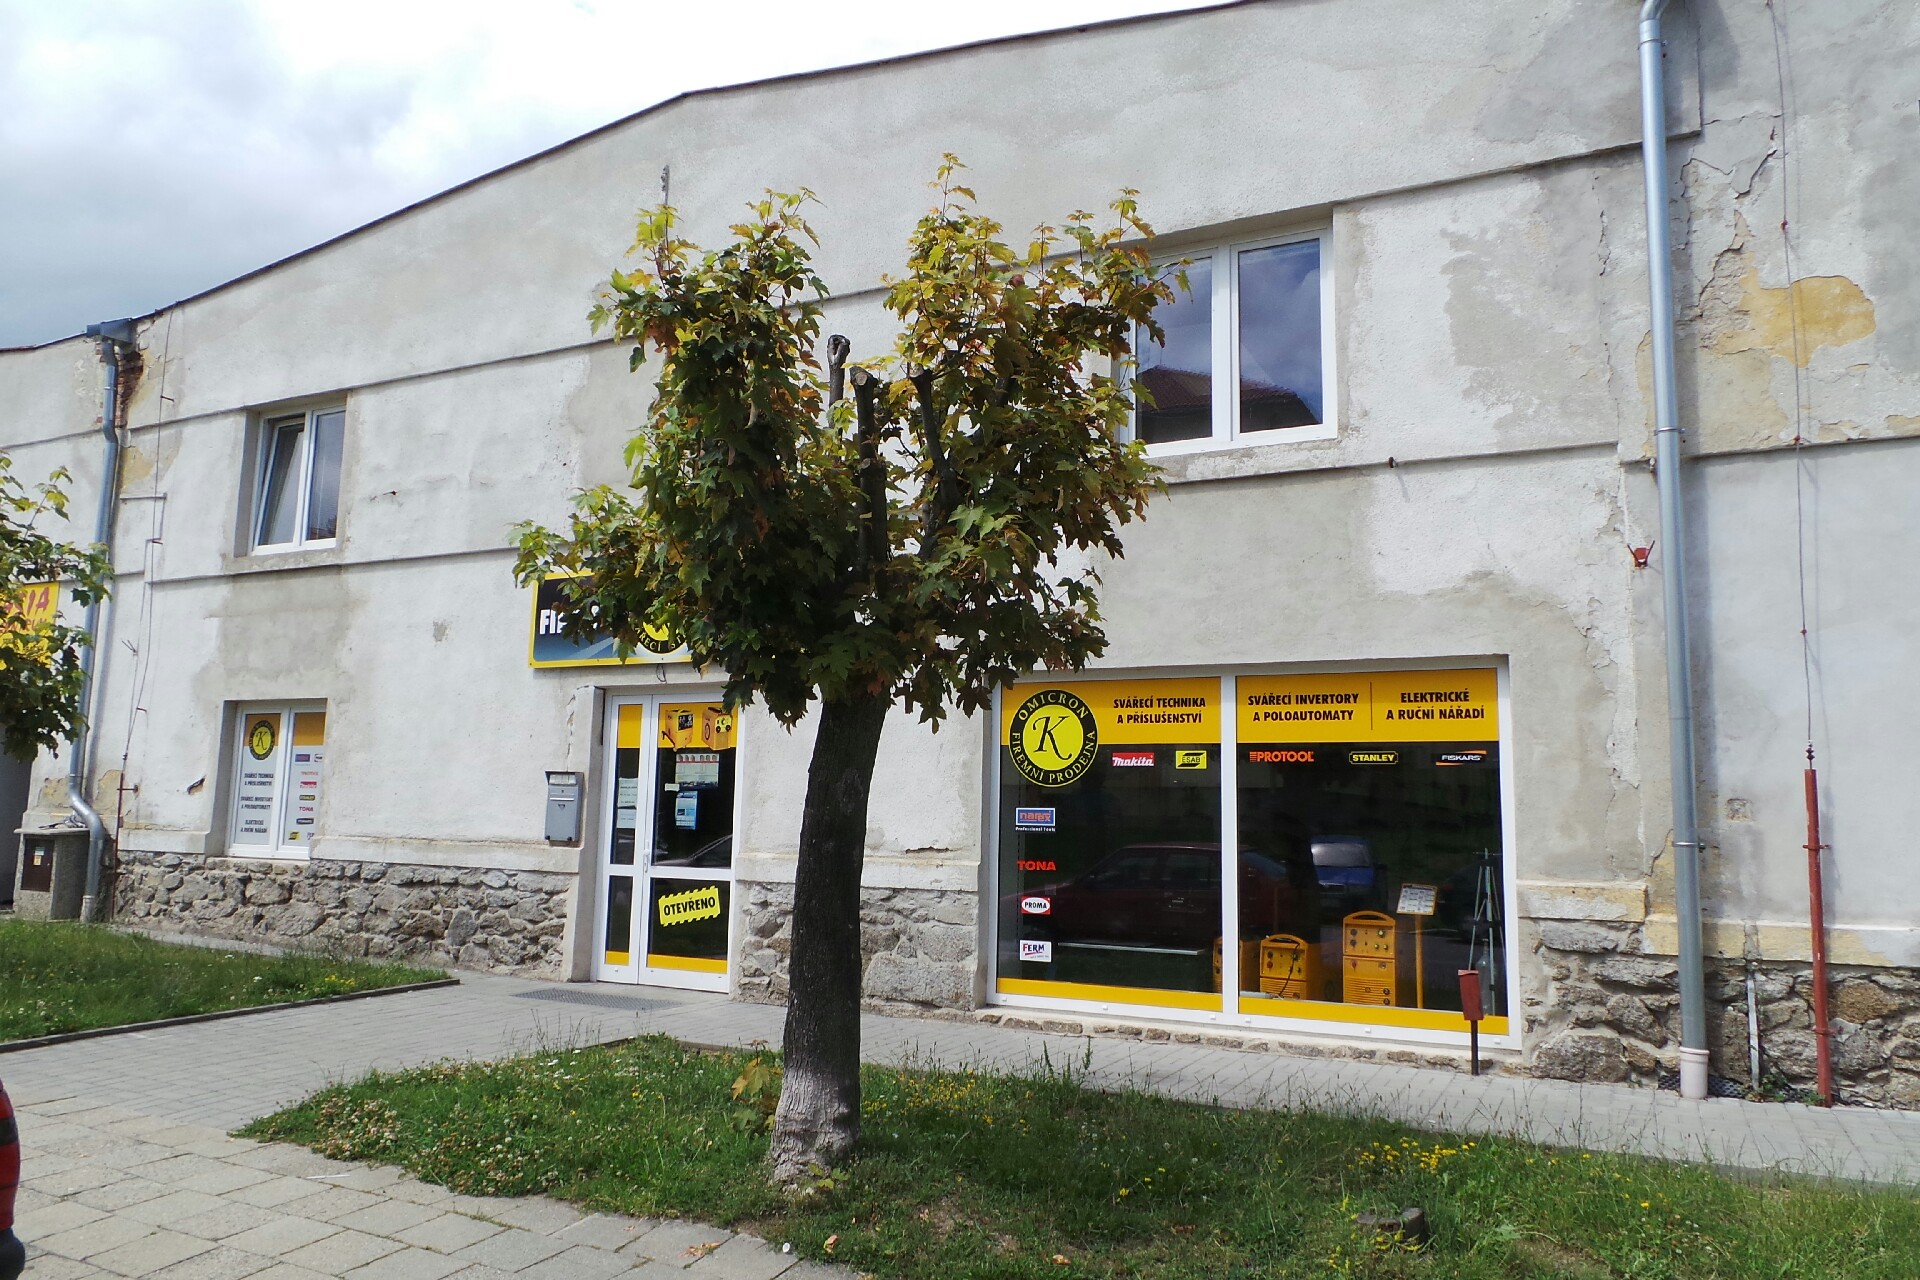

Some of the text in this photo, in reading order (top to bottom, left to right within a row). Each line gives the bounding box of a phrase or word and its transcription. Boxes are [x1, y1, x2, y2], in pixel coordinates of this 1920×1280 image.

[1113, 696, 1206, 709] SVÁŘECÍ TECHNIKA
[1248, 692, 1359, 706] SVÁŘECÍ INVERTORY
[1400, 688, 1470, 703] ELEKTRICKÉ
[1018, 692, 1089, 721] OMICRON
[1386, 705, 1485, 720] A RUČNÍ NÁŘADÍ
[1117, 710, 1202, 724] A PŘÍSLUŠENSTVÍ
[1253, 710, 1354, 722] A POLOAUTOMATY
[1032, 715, 1073, 761] K
[1012, 730, 1096, 783] FIREMNÍ PRODEJNA
[1257, 751, 1314, 763] PROTOOL
[1352, 754, 1395, 762] STANLEY
[1017, 861, 1056, 871] TONA
[663, 897, 716, 916] OTEVŘENO
[1024, 901, 1048, 909] PROMA
[1023, 943, 1045, 953] FERM
